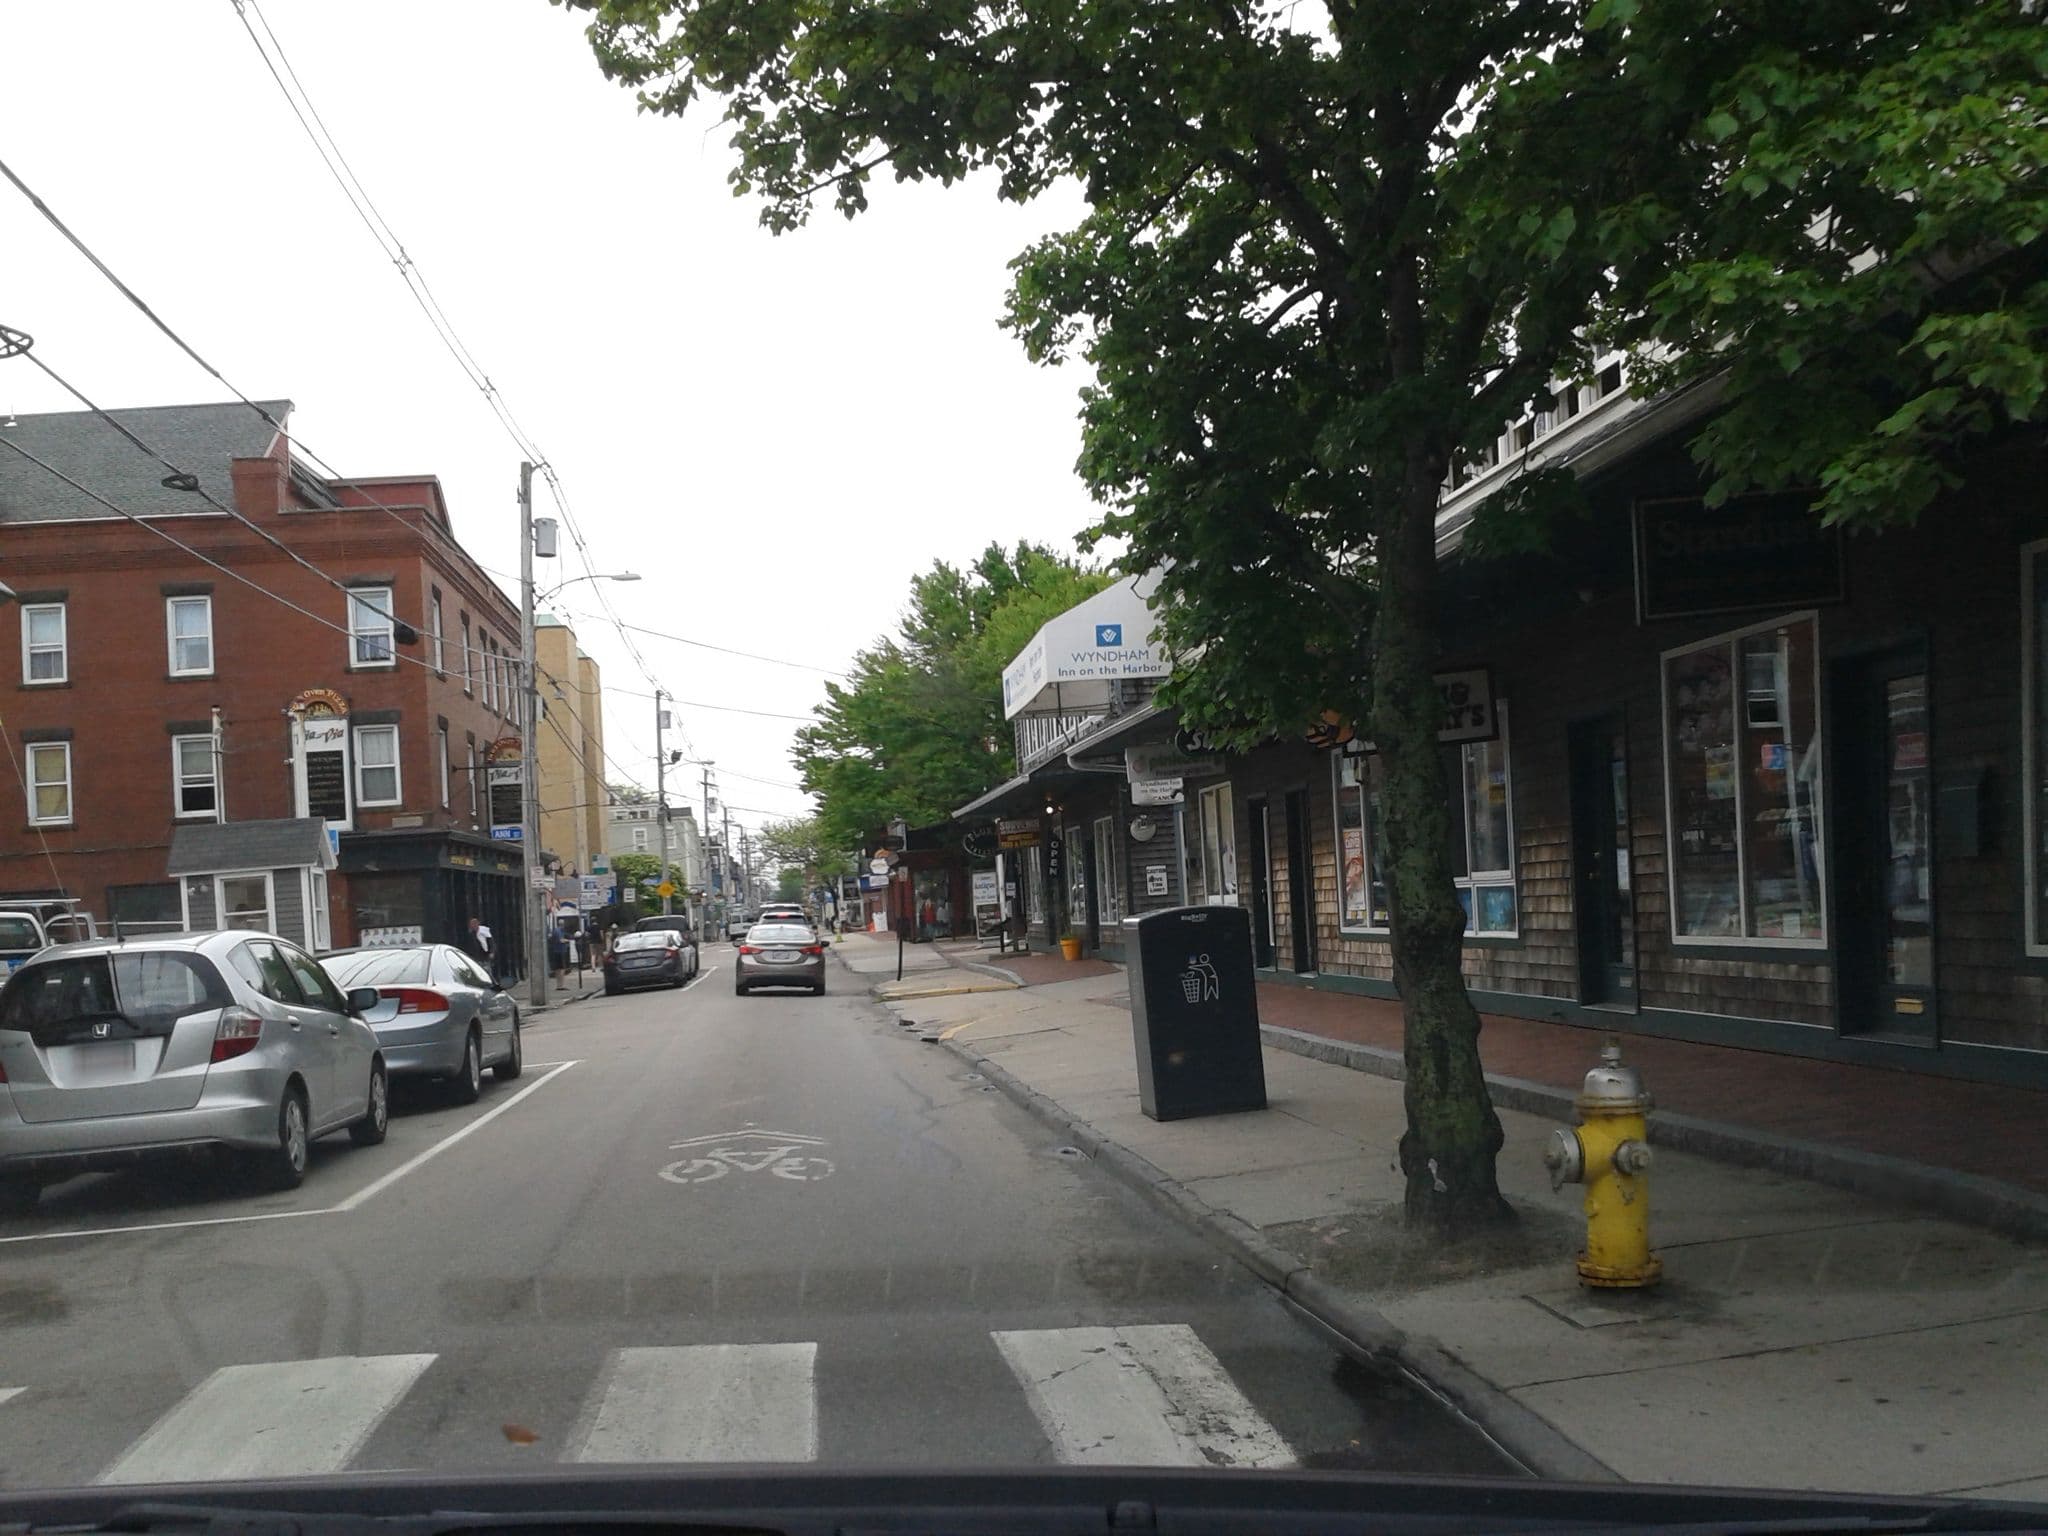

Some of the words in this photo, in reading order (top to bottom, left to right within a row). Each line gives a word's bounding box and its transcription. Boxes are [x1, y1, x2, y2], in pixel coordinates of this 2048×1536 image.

[1071, 649, 1149, 663] WYNDHAM
[1058, 667, 1076, 677] Inn
[1079, 668, 1094, 676] on
[1099, 665, 1118, 675] the
[1123, 663, 1163, 674] Harbor
[494, 829, 511, 839] ANN
[1049, 840, 1059, 876] OPEN
